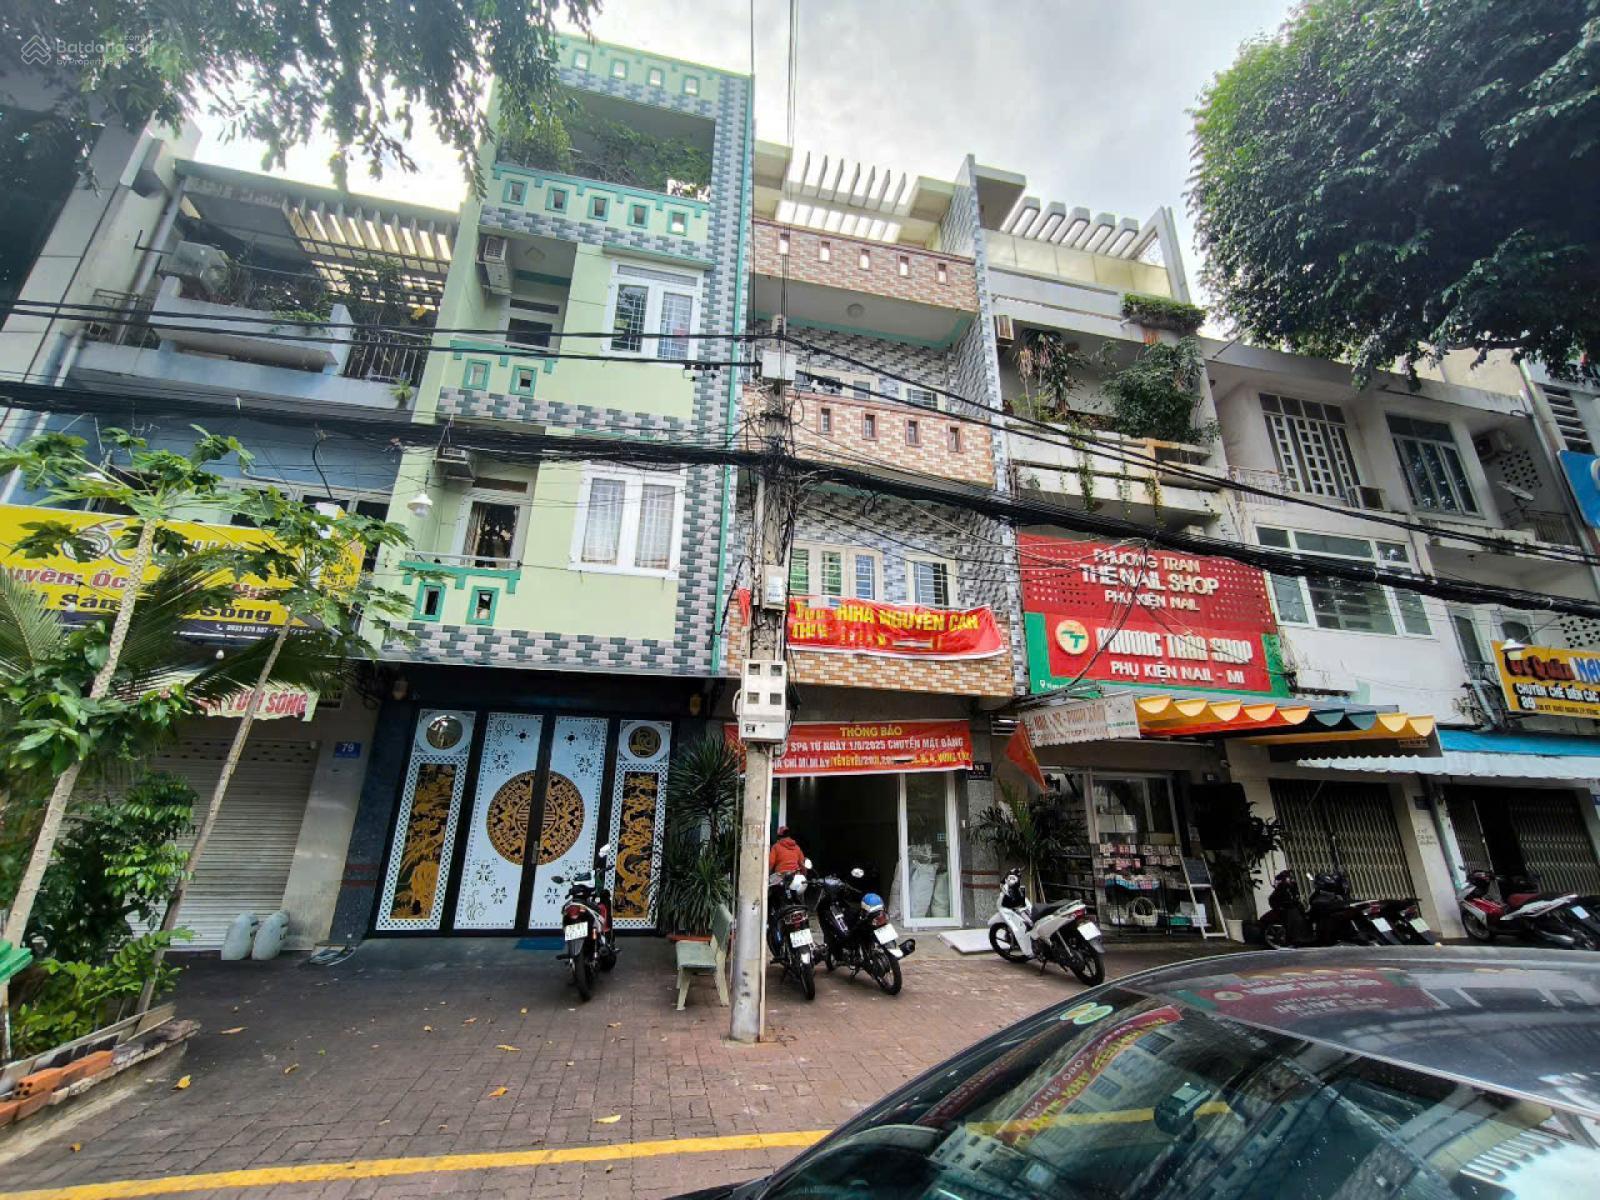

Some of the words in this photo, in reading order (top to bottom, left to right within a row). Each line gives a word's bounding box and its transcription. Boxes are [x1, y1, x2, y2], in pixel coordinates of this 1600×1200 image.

[1079, 563, 1120, 585] THE
[1119, 567, 1167, 591] NAIL
[1167, 573, 1220, 595] SHOP
[1169, 596, 1201, 611] NAIL
[1110, 660, 1140, 680] PHỤ
[1144, 661, 1179, 683] KIỆN
[1180, 666, 1214, 682] NAIL
[840, 725, 878, 736] THÔNG
[791, 742, 808, 752] SPA
